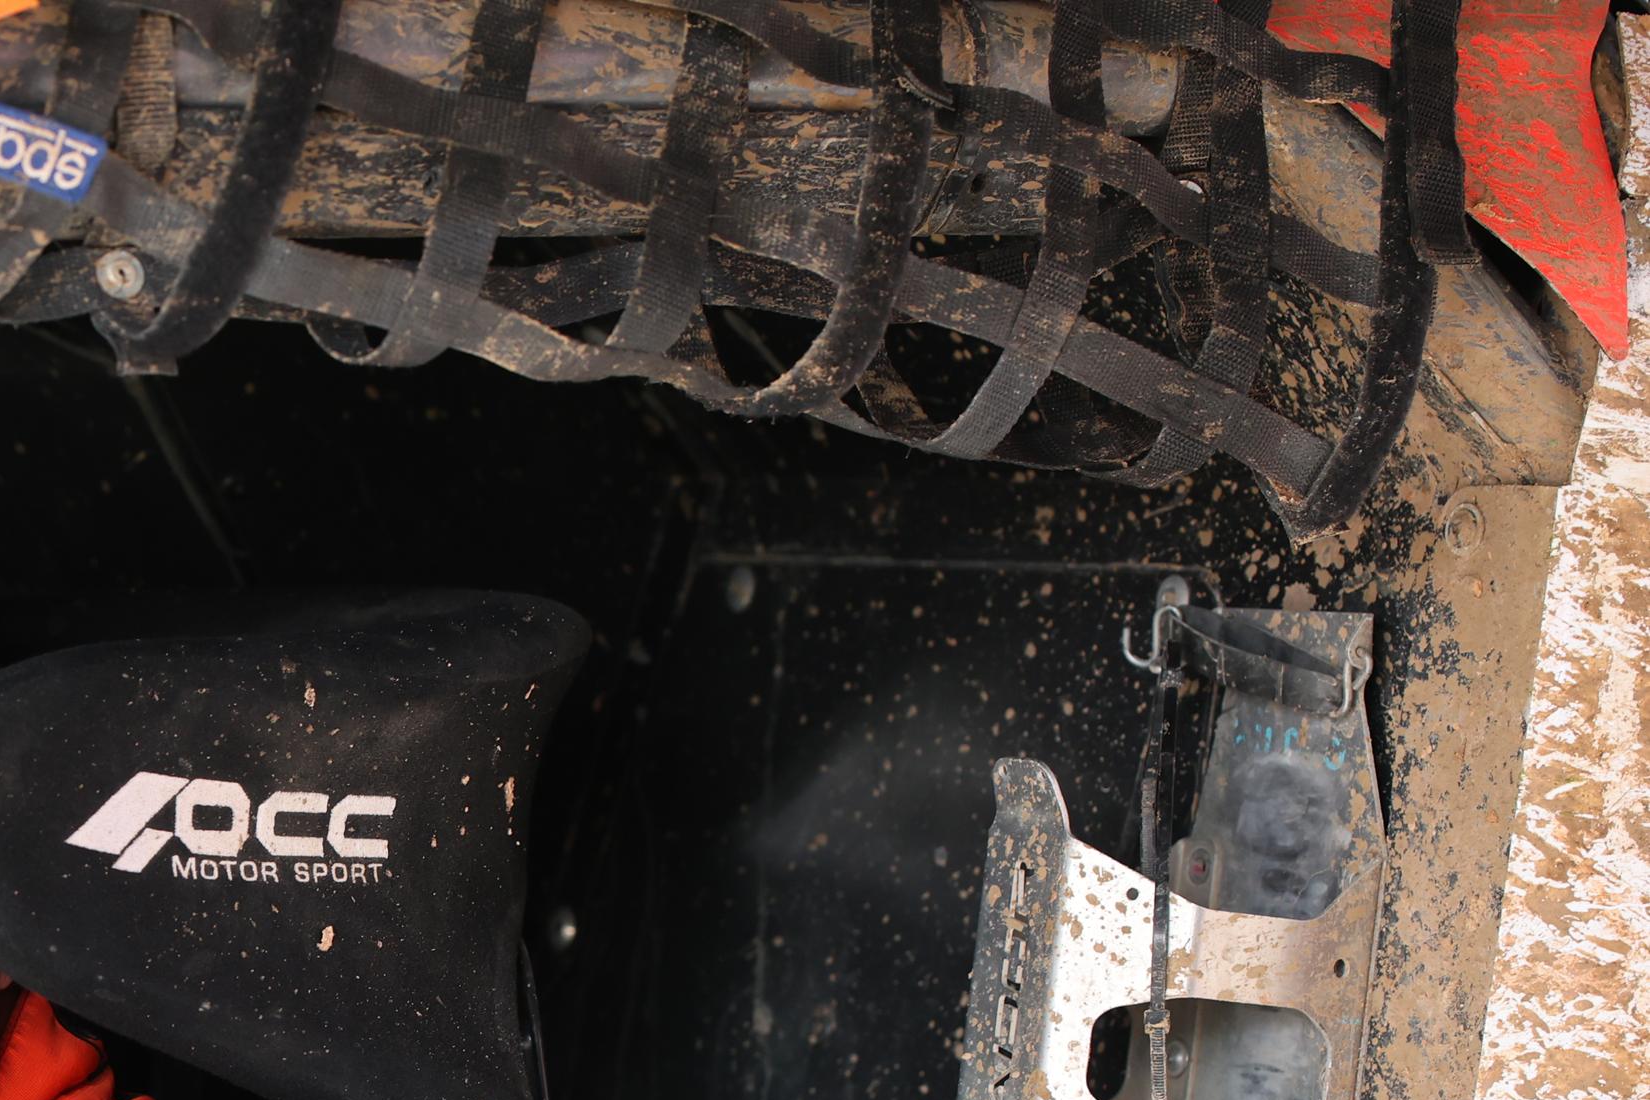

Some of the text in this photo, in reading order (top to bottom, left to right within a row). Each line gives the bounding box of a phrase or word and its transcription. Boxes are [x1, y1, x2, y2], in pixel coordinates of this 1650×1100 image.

[174, 778, 397, 860] OCC
[171, 855, 384, 884] MOTOR SPORT
